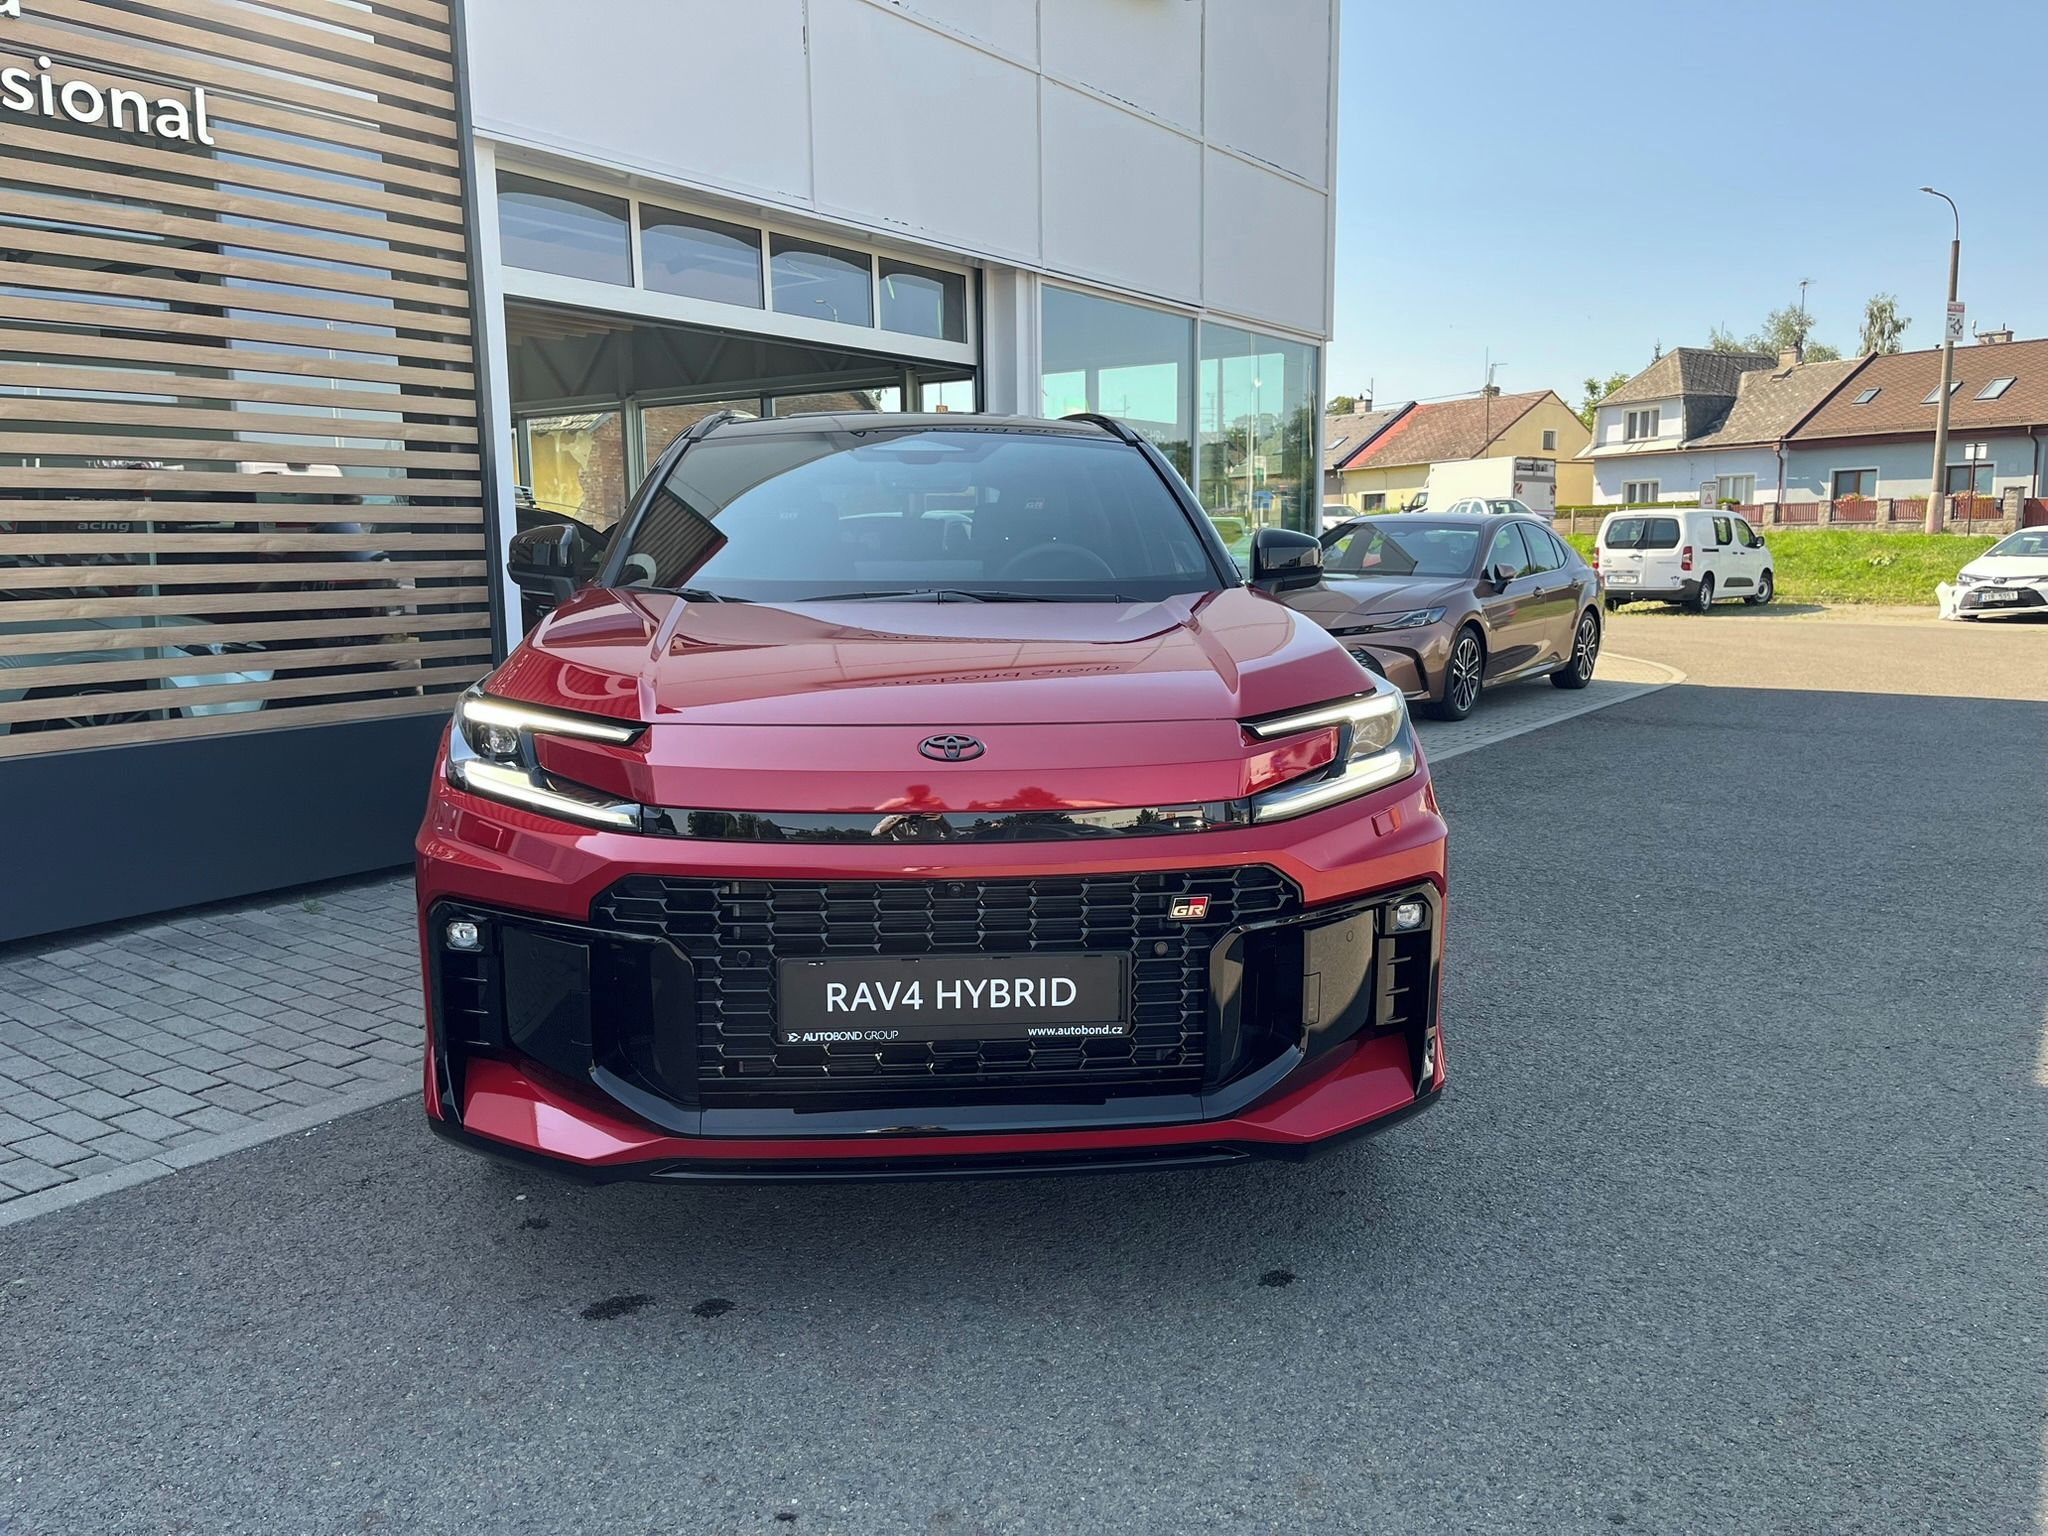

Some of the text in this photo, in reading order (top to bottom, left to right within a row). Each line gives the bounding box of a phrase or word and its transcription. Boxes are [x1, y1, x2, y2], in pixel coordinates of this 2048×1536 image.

[0, 55, 215, 146] sional
[826, 976, 1077, 1013] RAV4 HYBRID
[802, 1030, 899, 1042] AUTOBOND GROUP
[1027, 1024, 1123, 1036] www.autobond.cz
